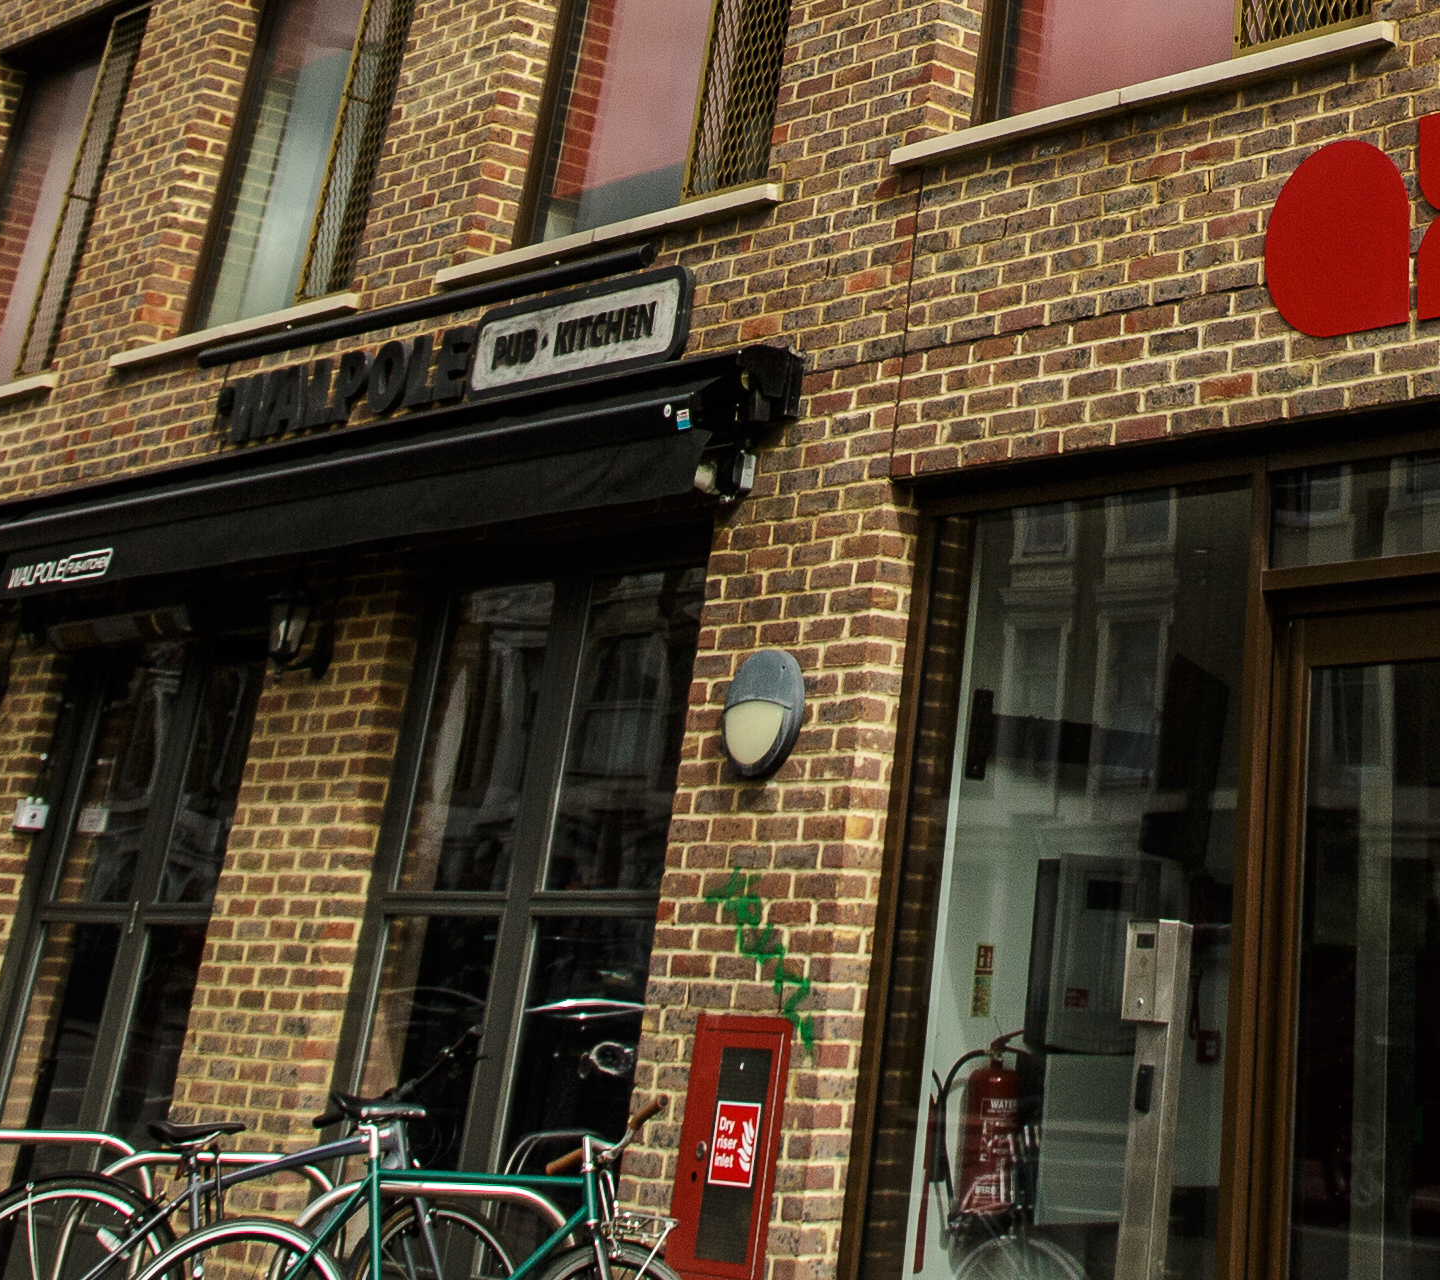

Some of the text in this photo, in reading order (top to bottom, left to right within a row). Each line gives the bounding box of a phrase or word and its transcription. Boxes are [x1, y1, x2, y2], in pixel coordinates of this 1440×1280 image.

[231, 301, 658, 441] WALPOLE PUB KITCHEN
[990, 1099, 1018, 1110] WATE
[719, 1116, 735, 1135] Dry
[716, 1134, 738, 1150] riser
[714, 1151, 734, 1168] inlet
